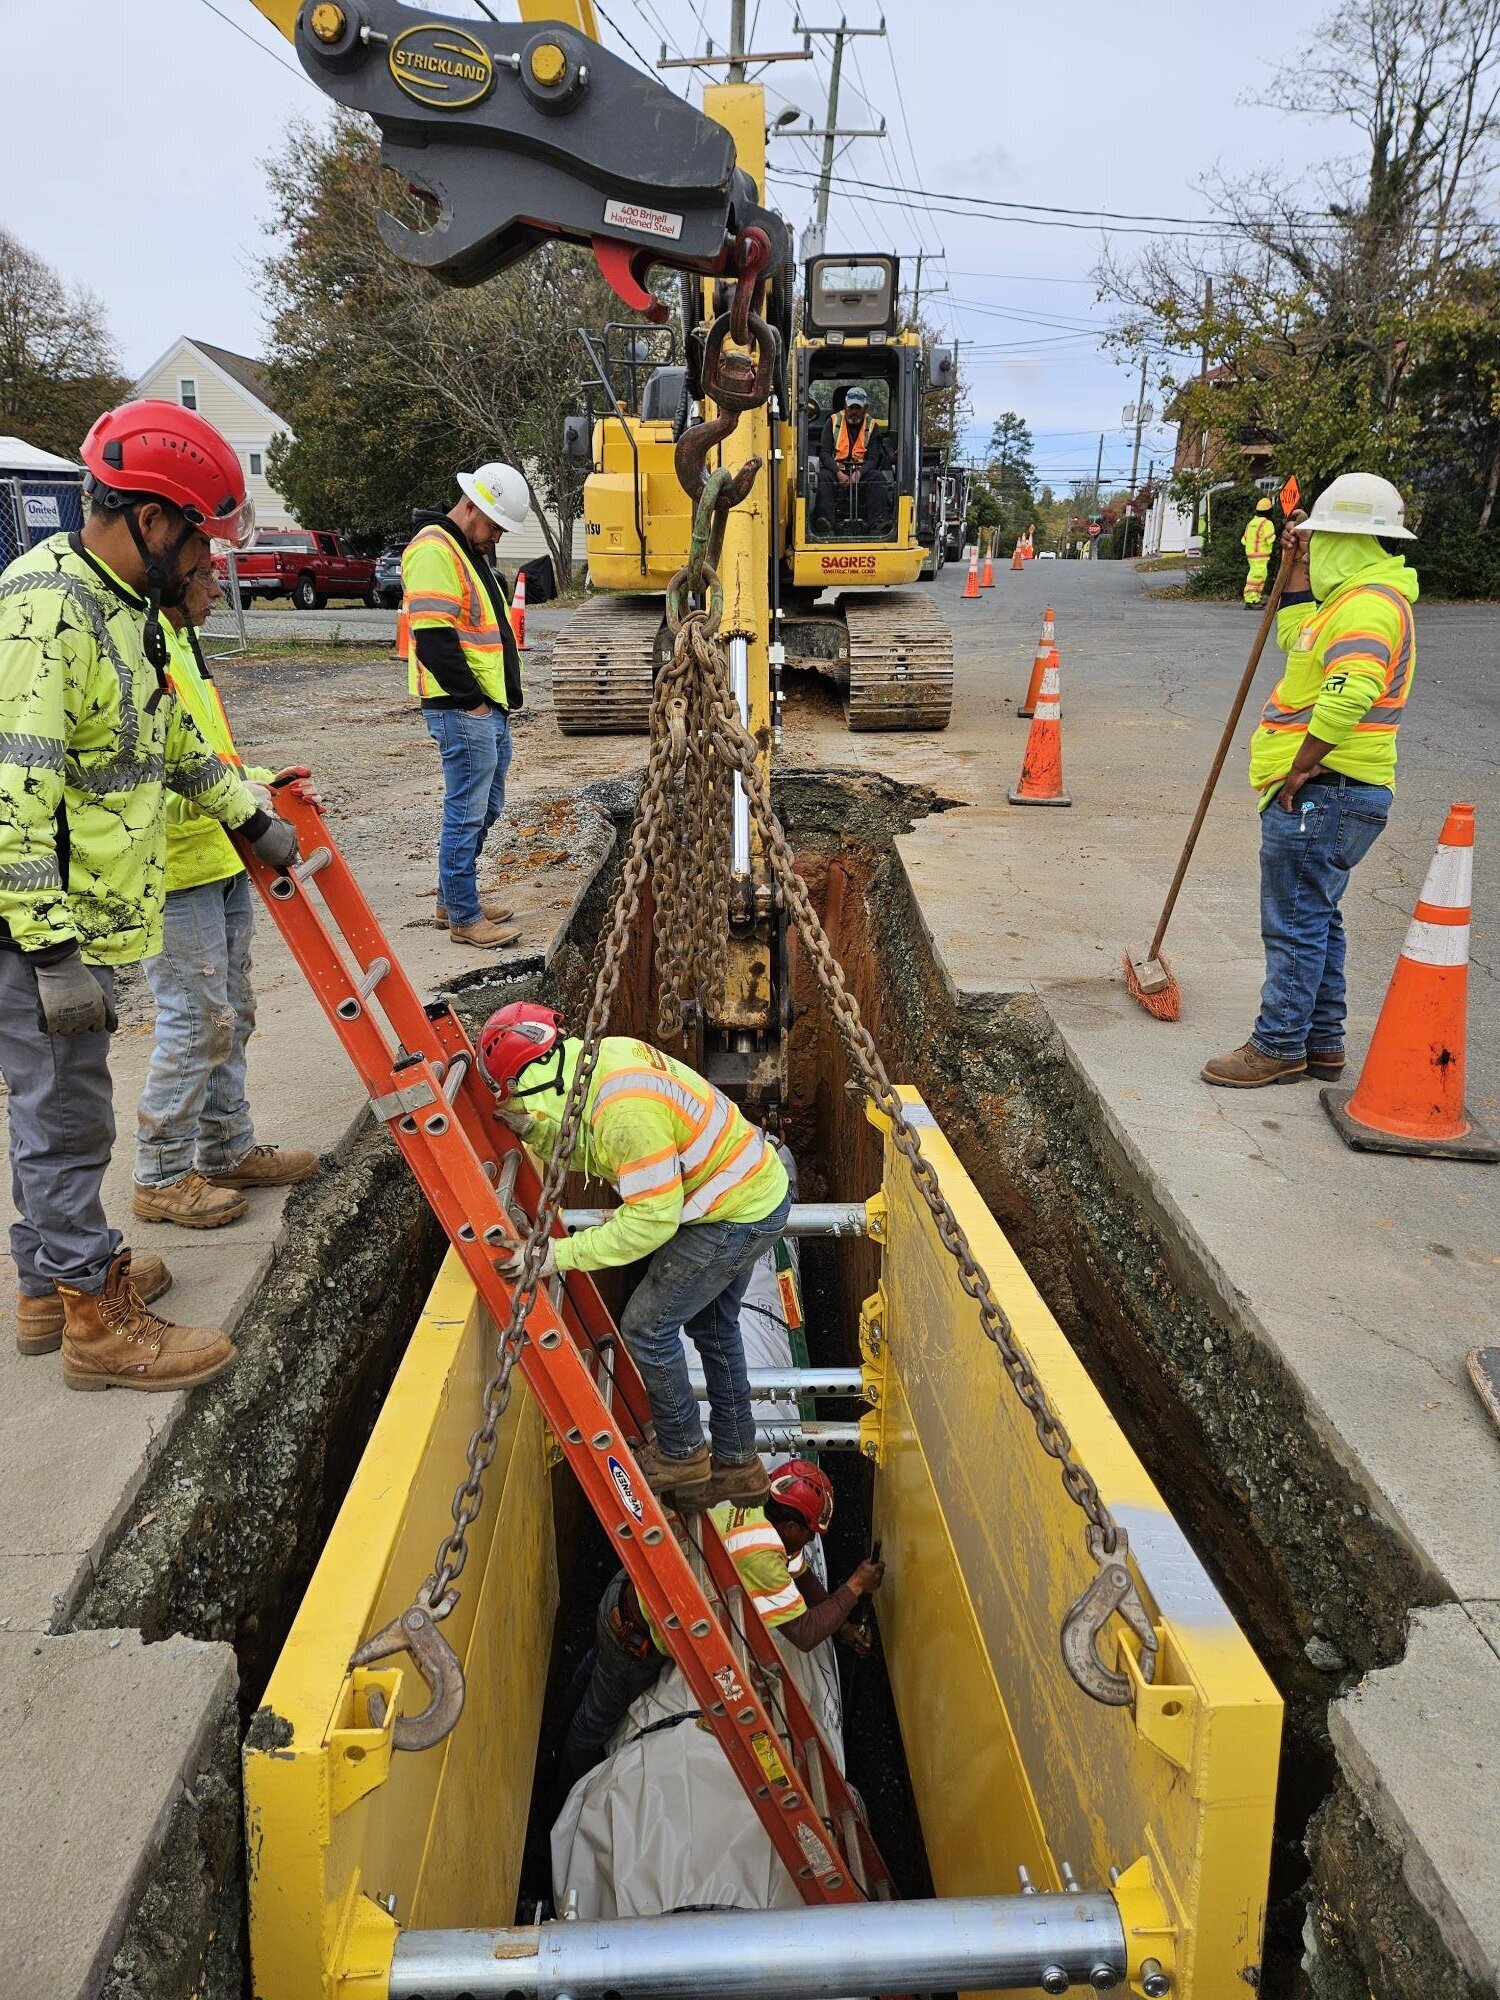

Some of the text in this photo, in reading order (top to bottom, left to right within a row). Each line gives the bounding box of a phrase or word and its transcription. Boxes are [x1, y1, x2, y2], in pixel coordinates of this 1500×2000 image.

[396, 50, 486, 82] STRICKLAND
[610, 211, 675, 235] Hardened Steel
[621, 205, 667, 224] 400 Brinell
[1282, 488, 1298, 504] SLOW
[28, 504, 57, 515] United
[821, 556, 876, 568] SAGRES
[614, 1471, 641, 1513] WERNER
